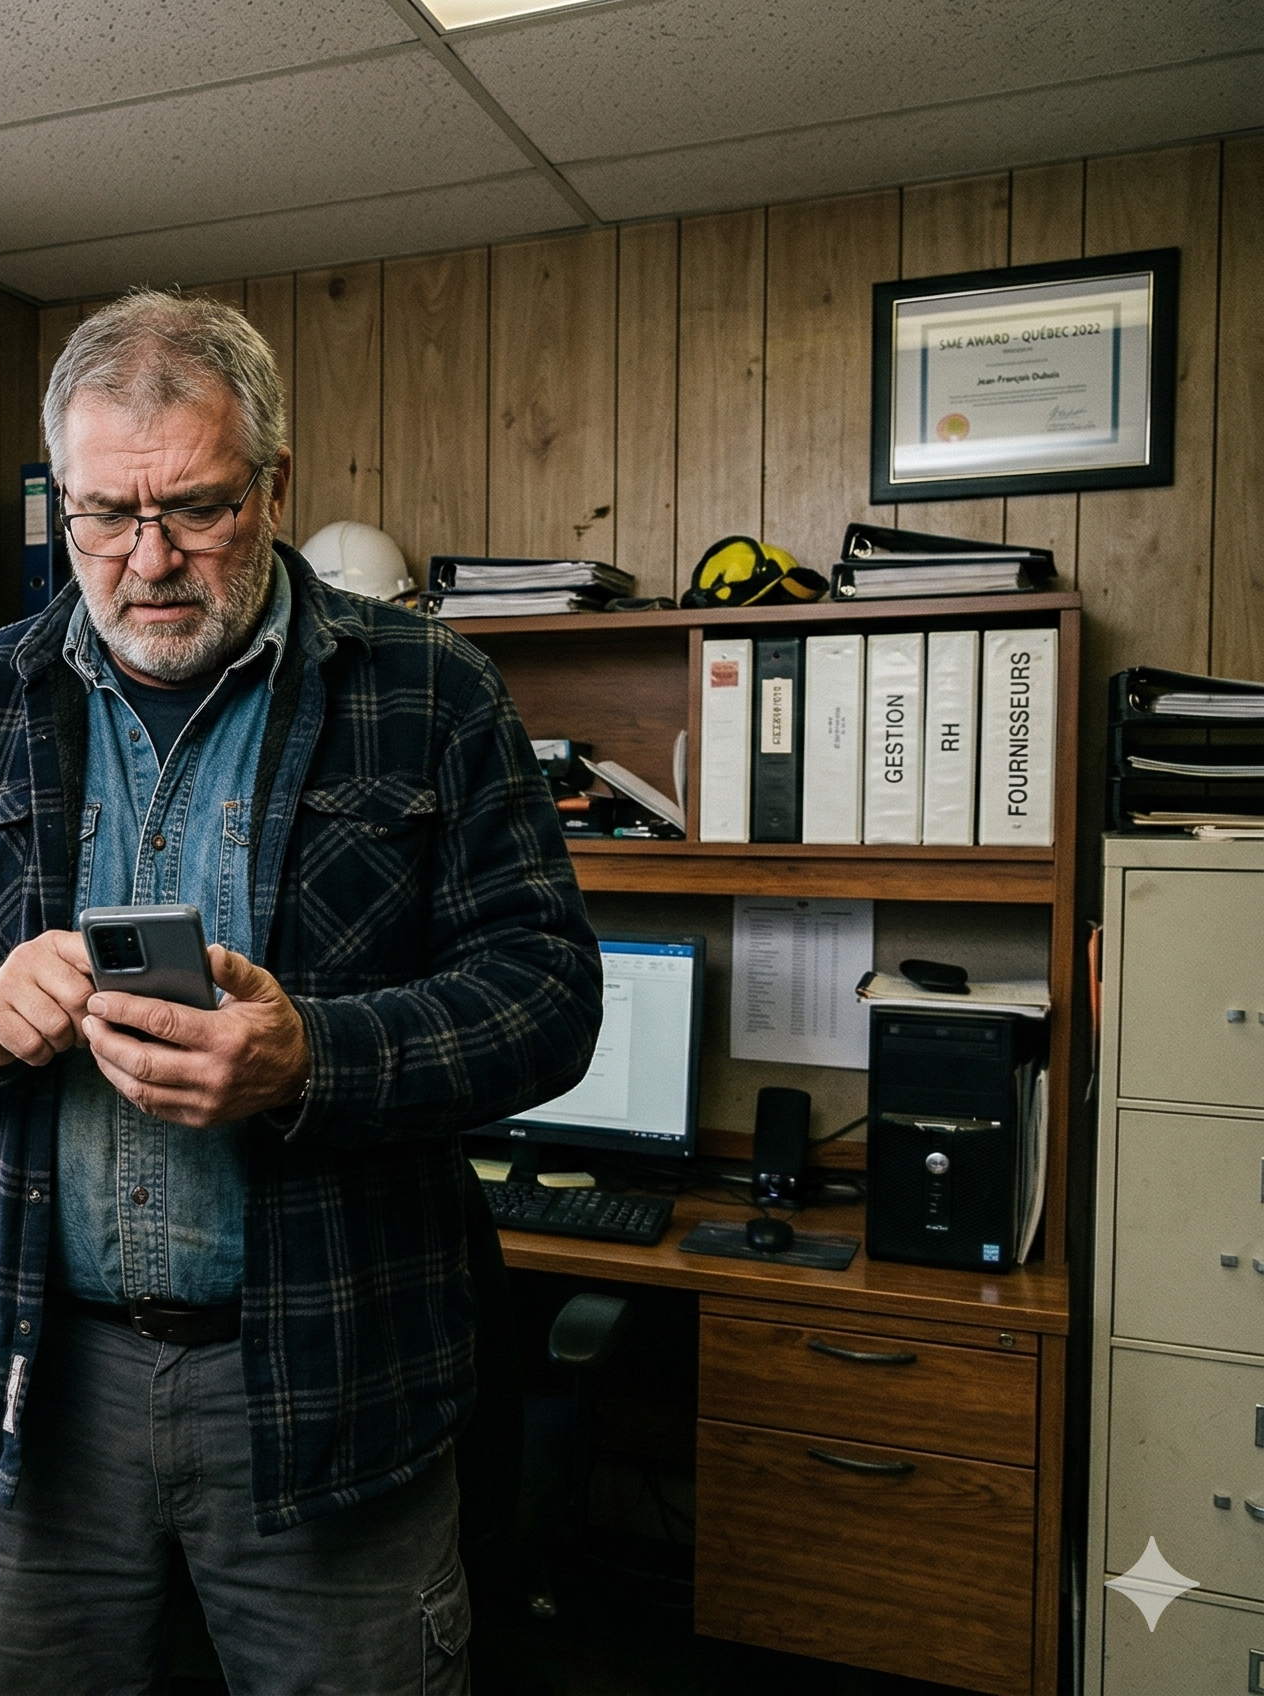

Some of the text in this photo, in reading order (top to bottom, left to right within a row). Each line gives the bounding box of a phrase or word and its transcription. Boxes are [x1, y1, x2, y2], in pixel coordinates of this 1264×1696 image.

[939, 336, 963, 351] SME
[966, 332, 1010, 348] AWARD
[1072, 323, 1101, 337] 2022
[884, 694, 904, 784] GESTION
[940, 723, 960, 752] RH
[1007, 650, 1031, 816] FOURNISSEURS
